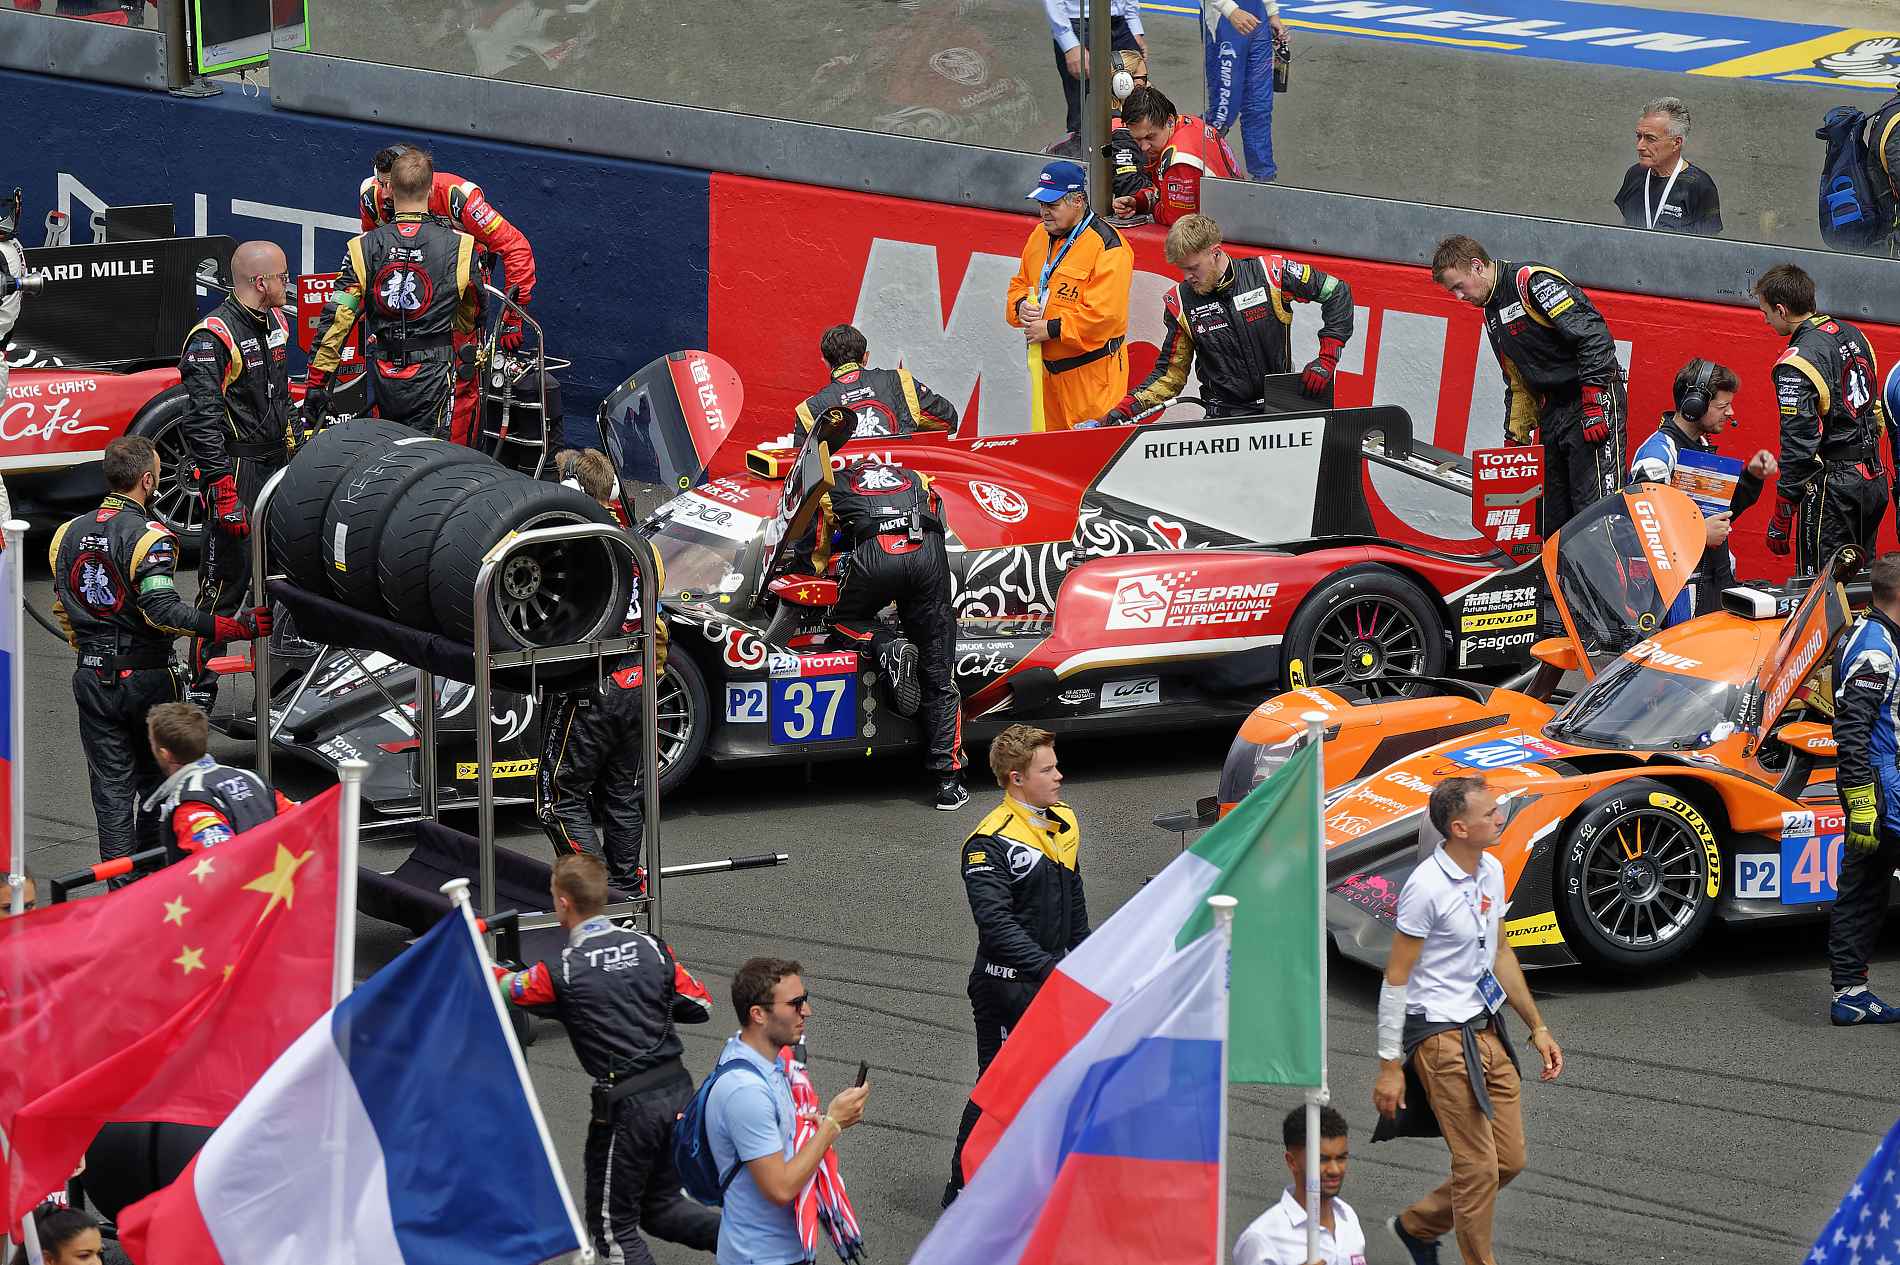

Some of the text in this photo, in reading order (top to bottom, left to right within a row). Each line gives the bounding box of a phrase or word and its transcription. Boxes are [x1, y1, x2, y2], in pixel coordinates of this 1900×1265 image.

[1280, 0, 1752, 53] HELIN
[1213, 59, 1233, 130] SMP RACING
[91, 259, 155, 277] MILLE
[303, 278, 335, 290] TOT
[7, 379, 97, 399] ACKIE CHAN'S
[0, 398, 110, 441] Café
[1144, 431, 1313, 459] RICHARD MILLE
[831, 451, 903, 472] OTAL
[1478, 453, 1539, 465] TOTAL
[1479, 465, 1539, 480] 道达尔
[879, 517, 909, 532] MRTC
[1174, 582, 1279, 604] SEPANG
[1170, 598, 1273, 615] INTERNATIONAL
[1462, 600, 1535, 613] Future Racing Media
[1166, 609, 1270, 628] CIRCUIT
[1475, 613, 1534, 626] DUNLOP
[1477, 632, 1535, 650] sagcom
[802, 656, 855, 669] TOTAL
[956, 650, 1015, 677] Café
[729, 688, 763, 717] P2
[783, 679, 847, 739] 37
[1738, 692, 1751, 725] J.ALLEN
[331, 735, 363, 761] TOTAL
[1463, 744, 1534, 767] 40
[1571, 840, 1586, 864] SET
[1611, 800, 1628, 815] FL
[1817, 816, 1846, 829] TOT
[1670, 800, 1720, 888] DUNLOP
[1740, 861, 1776, 892] P2
[1505, 923, 1557, 938] DUNLOP
[584, 941, 639, 968] TDS
[984, 962, 1018, 979] MRTC
